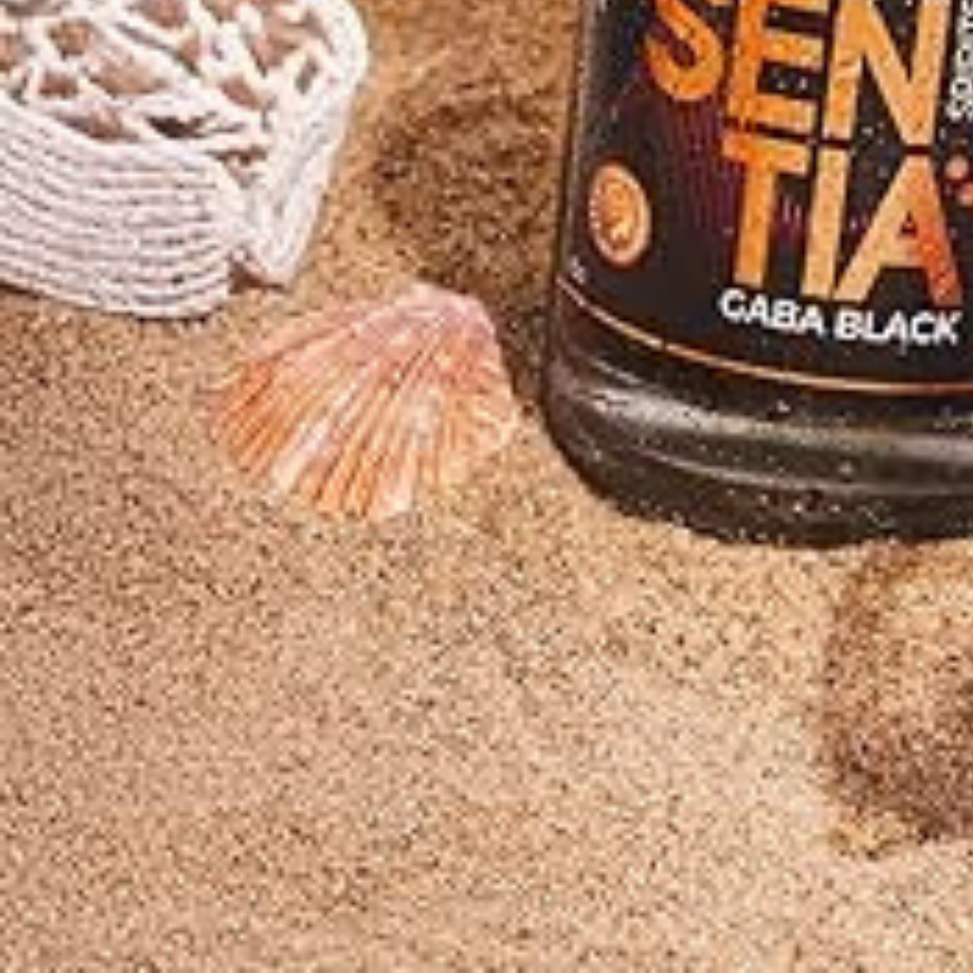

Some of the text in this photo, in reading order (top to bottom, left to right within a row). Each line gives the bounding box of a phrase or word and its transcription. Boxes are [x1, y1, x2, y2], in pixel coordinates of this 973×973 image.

[721, 129, 964, 308] TIA
[718, 287, 826, 338] GABA
[832, 308, 964, 346] BLACK
